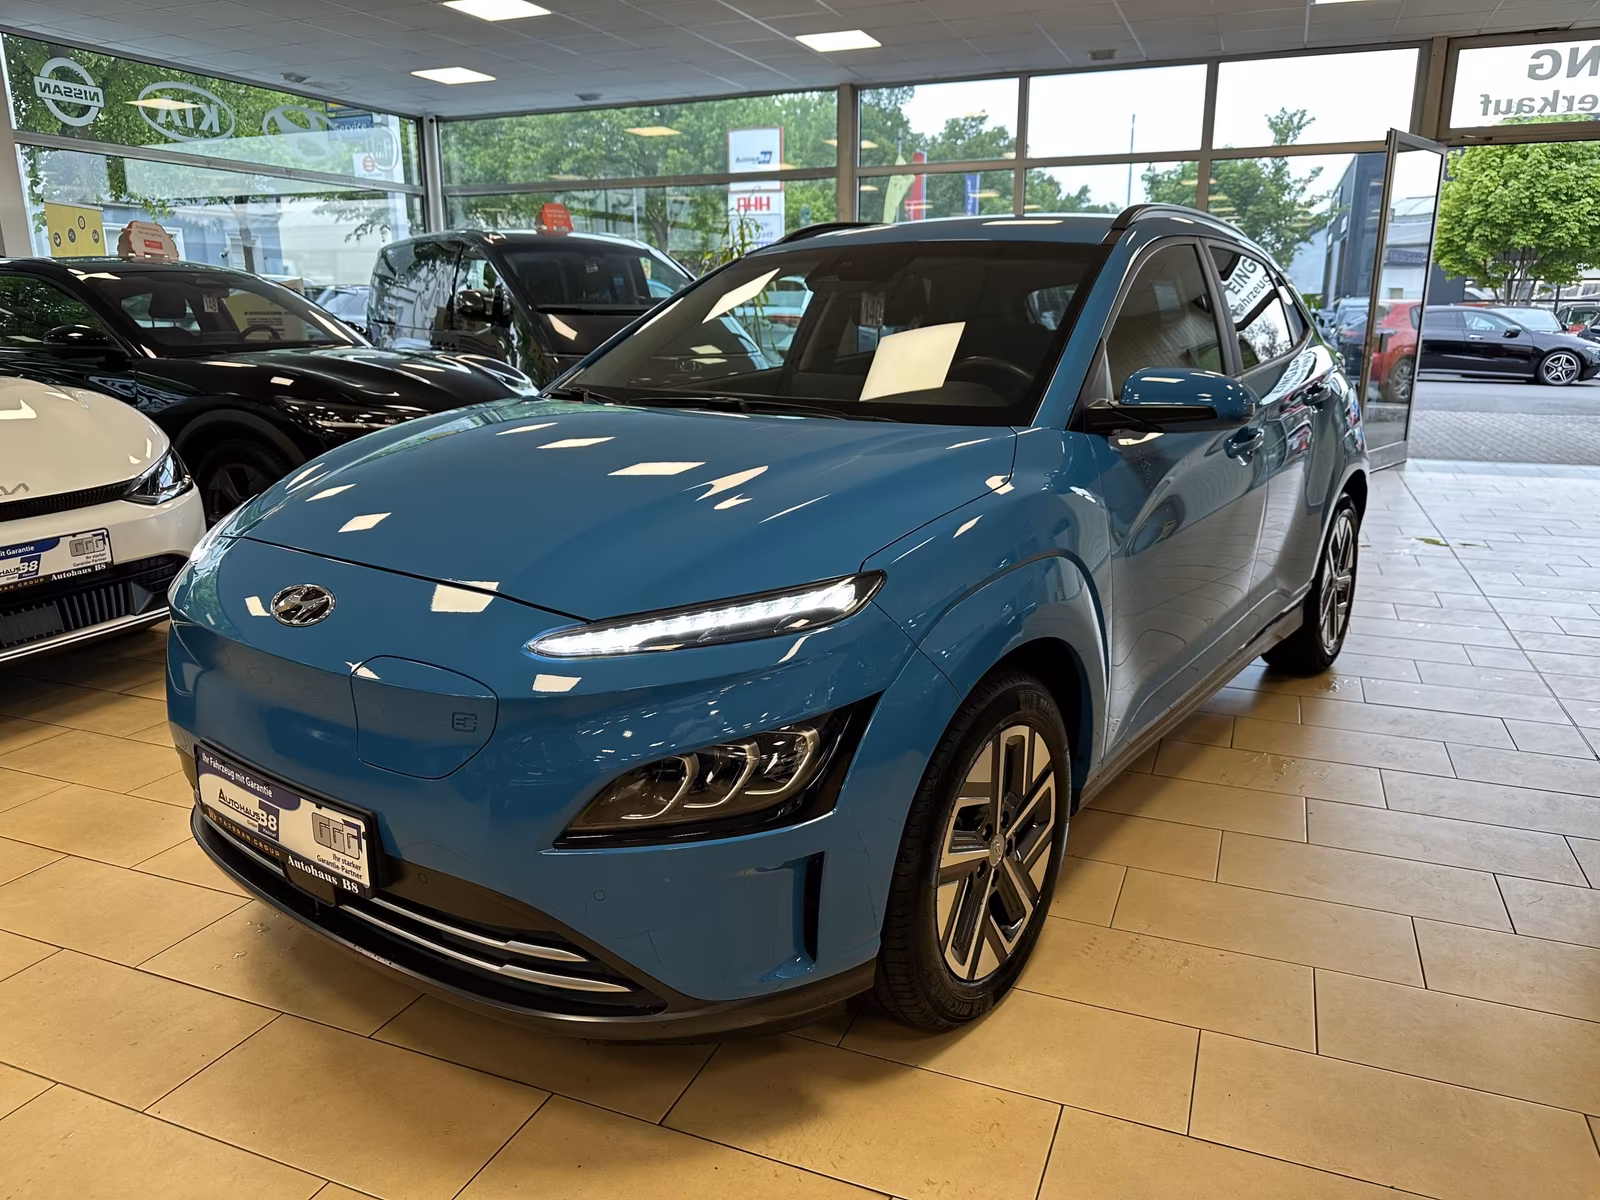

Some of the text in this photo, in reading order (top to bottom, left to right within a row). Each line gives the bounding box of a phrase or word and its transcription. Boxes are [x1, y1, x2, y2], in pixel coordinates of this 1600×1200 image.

[334, 121, 367, 133] Service
[6, 545, 35, 556] Garantie
[19, 560, 38, 573] B8
[51, 563, 107, 581] Autohaus B8
[18, 578, 44, 588] GROUP
[202, 752, 273, 798] Ihr Fahrzeug mit Garantie
[218, 788, 261, 821] AUTOHAUS
[258, 809, 278, 832] B8
[253, 839, 280, 857] GROUP
[316, 854, 363, 880] Garantie-Partner
[332, 853, 362, 872] Ihr starker
[287, 855, 359, 894] Autohaus B8
